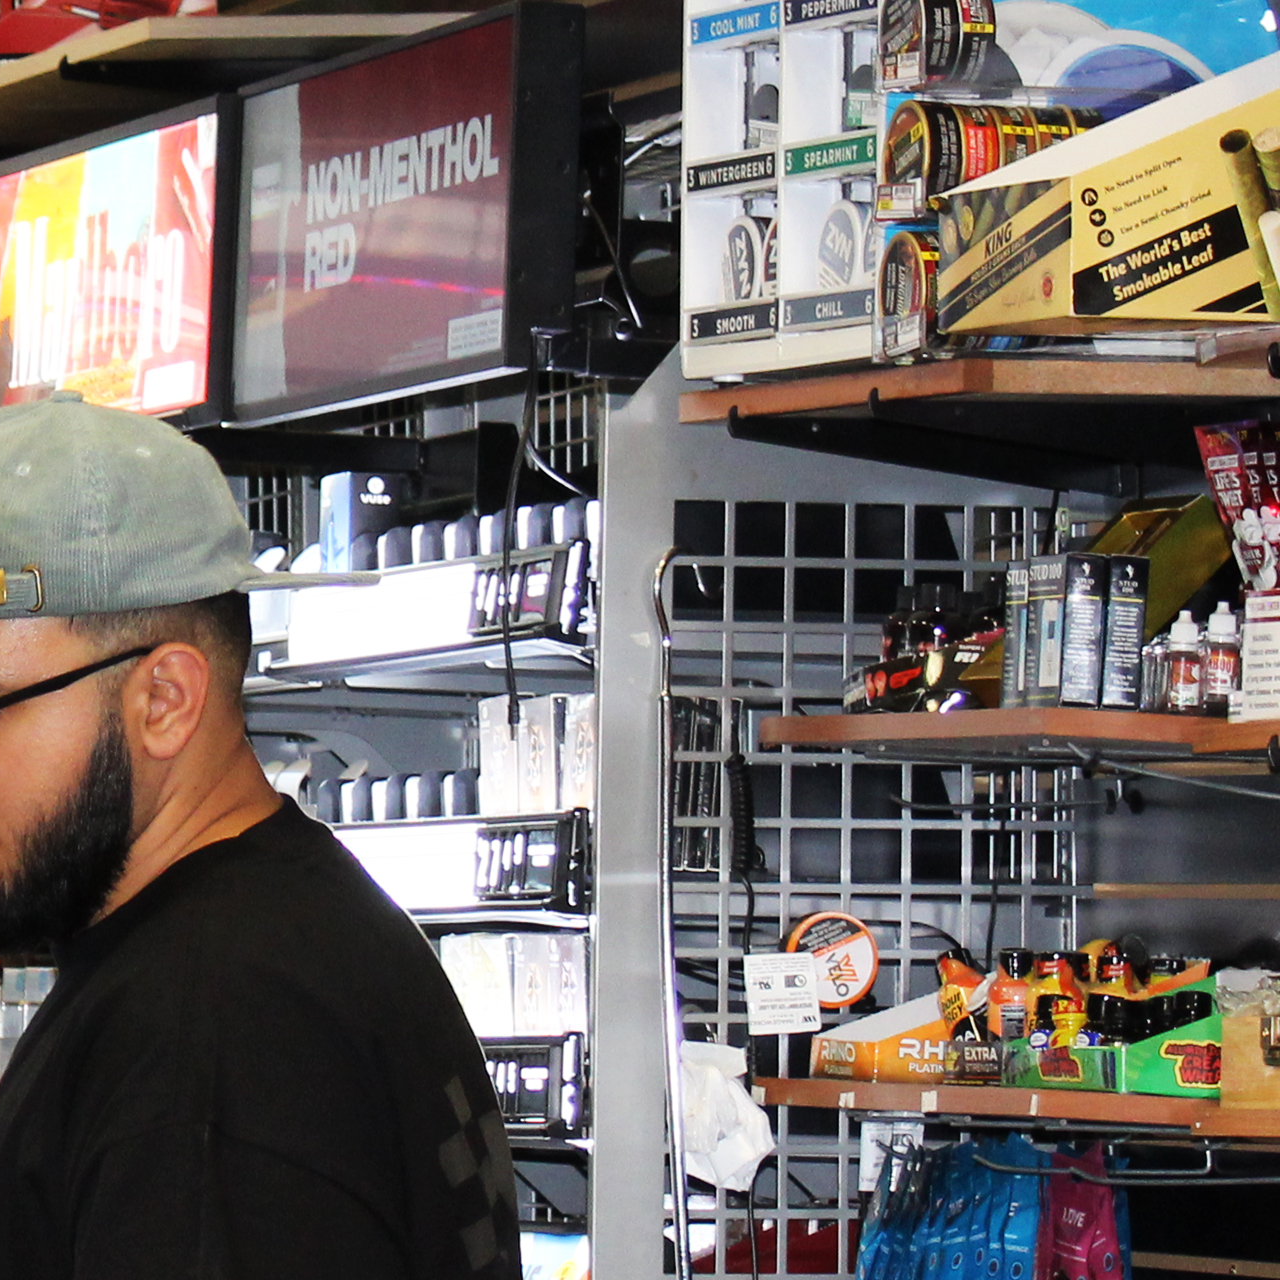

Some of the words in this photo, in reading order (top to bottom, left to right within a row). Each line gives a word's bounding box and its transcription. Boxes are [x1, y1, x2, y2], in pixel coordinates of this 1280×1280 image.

[692, 22, 700, 40] 3
[710, 19, 735, 35] COOL
[737, 13, 761, 31] MINT
[769, 10, 777, 24] 6
[786, 5, 793, 22] 3
[786, 152, 793, 170] 3
[804, 145, 858, 168] SPEARMINT
[867, 139, 874, 157] 6
[1162, 156, 1182, 168] Open
[306, 113, 500, 225] NON-MENTHOL
[688, 171, 695, 187] 3
[698, 160, 764, 186] WINTERGREEN
[766, 156, 772, 174] 6
[1190, 189, 1212, 203] Grind
[826, 223, 853, 263] ZYN
[984, 222, 1013, 258] KING
[303, 222, 357, 293] RED
[1099, 262, 1127, 283] The
[1127, 237, 1180, 266] World's
[1180, 223, 1212, 248] Best
[1113, 262, 1181, 301] Smokable
[1181, 244, 1214, 272] Leaf
[9, 210, 185, 389] Marlboro
[785, 305, 792, 324] 3
[815, 300, 844, 318] CHILL
[865, 295, 873, 312] 6
[692, 319, 699, 336] 3
[716, 314, 756, 334] SMOOTH
[769, 307, 776, 325] 6
[360, 493, 392, 505] vuse
[1006, 569, 1028, 587] STUD
[1030, 564, 1049, 582] STUD
[1049, 562, 1063, 580] 100
[1118, 580, 1139, 589] STUD
[825, 952, 850, 998] VELO
[821, 1041, 856, 1063] RHINO
[898, 1038, 944, 1060] RH
[964, 1046, 999, 1062] EXTRA
[1183, 1055, 1222, 1068] CREA
[965, 1063, 999, 1074] STRENGTH
[1062, 1207, 1085, 1228] LOVE
